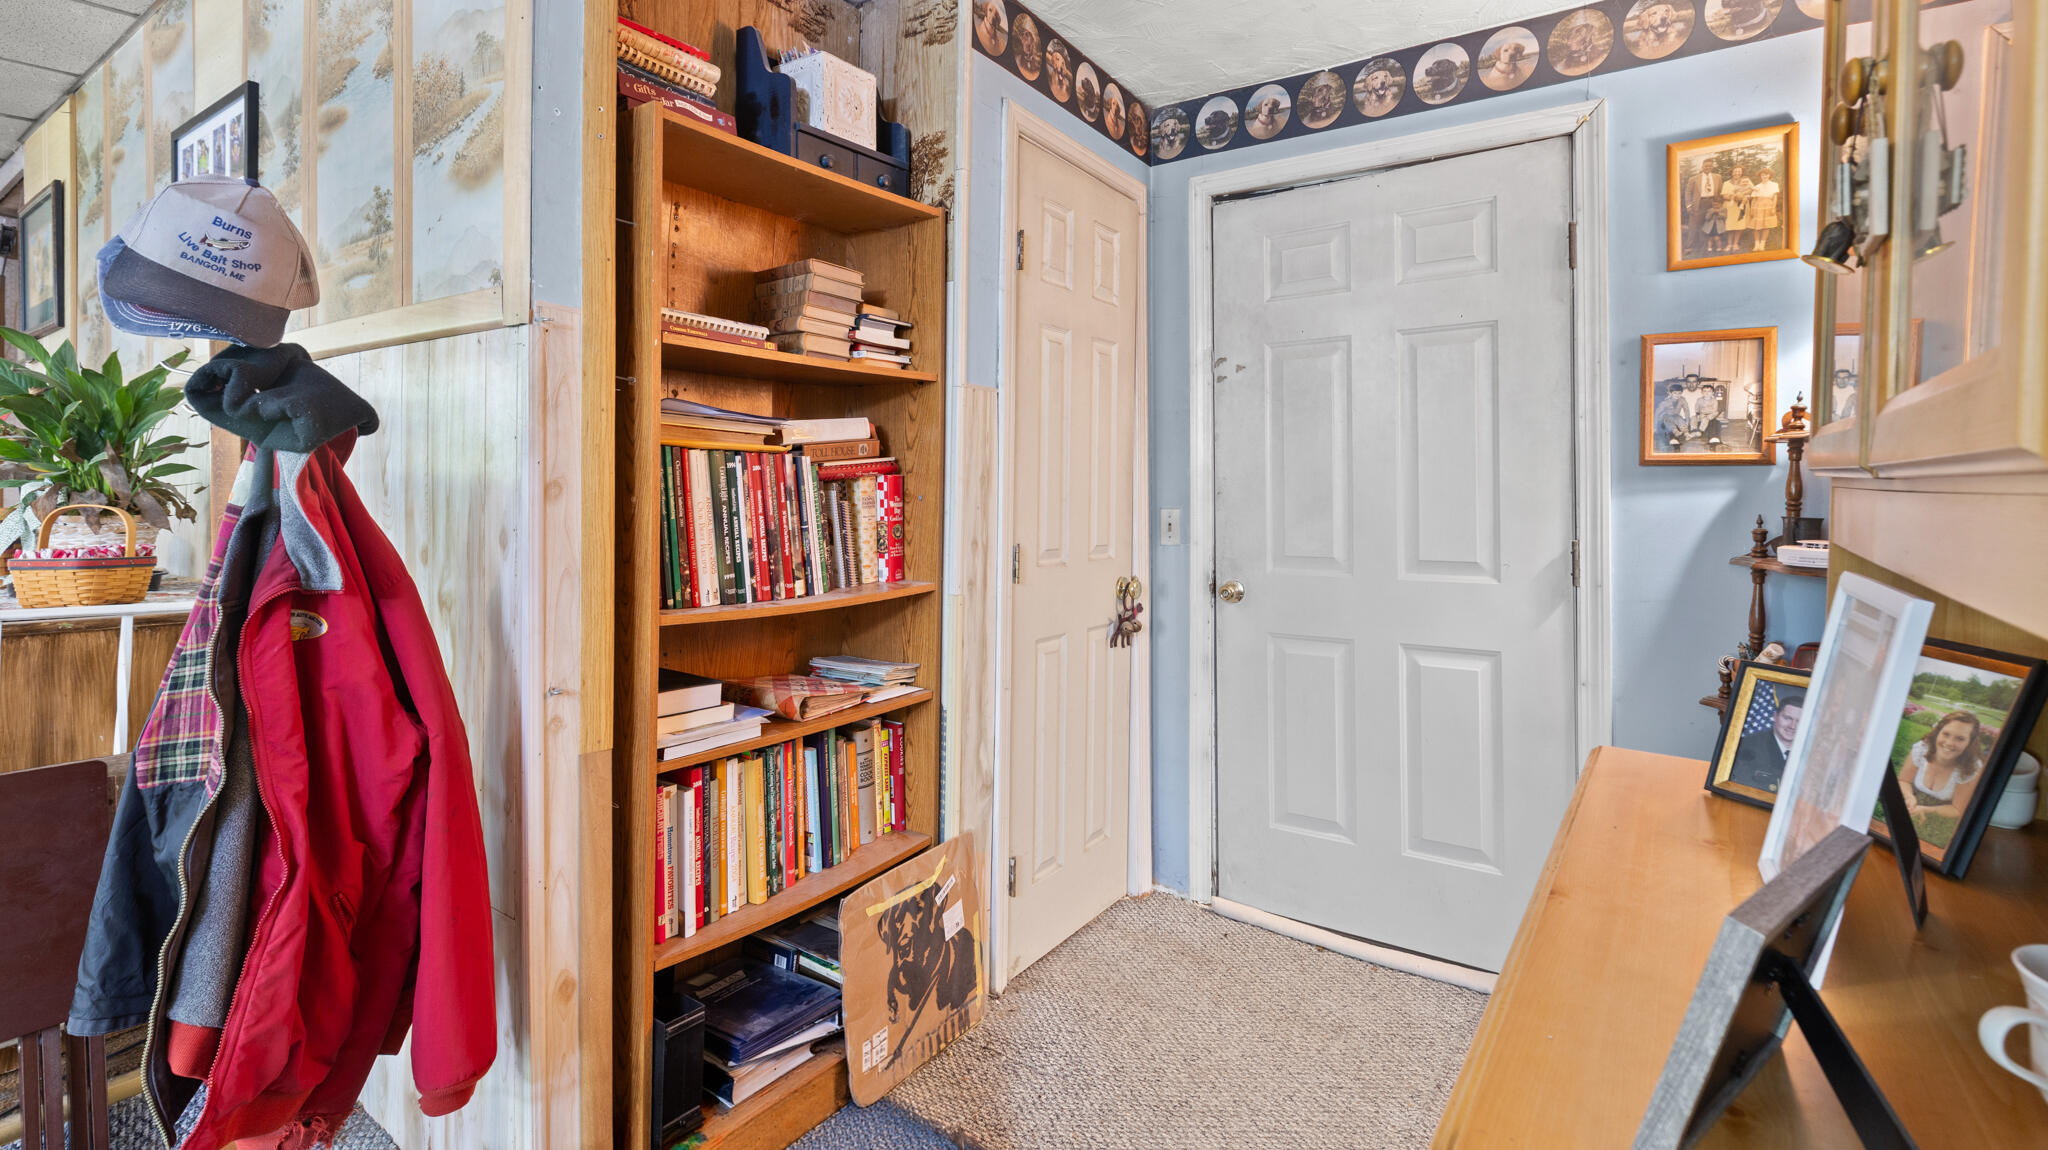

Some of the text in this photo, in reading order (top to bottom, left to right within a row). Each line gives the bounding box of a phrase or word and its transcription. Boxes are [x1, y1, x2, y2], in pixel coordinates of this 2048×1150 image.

[633, 82, 656, 96] Gifts
[212, 216, 253, 239] Burns
[178, 231, 262, 272] Live Bait Shop
[180, 251, 246, 281] BANGOR, ME
[811, 446, 856, 458] TOLL HOUSE
[812, 481, 821, 526] BAREFOOT
[816, 528, 822, 536] IN
[734, 540, 742, 563] RECIPES
[656, 793, 664, 834] CHOCOLATE
